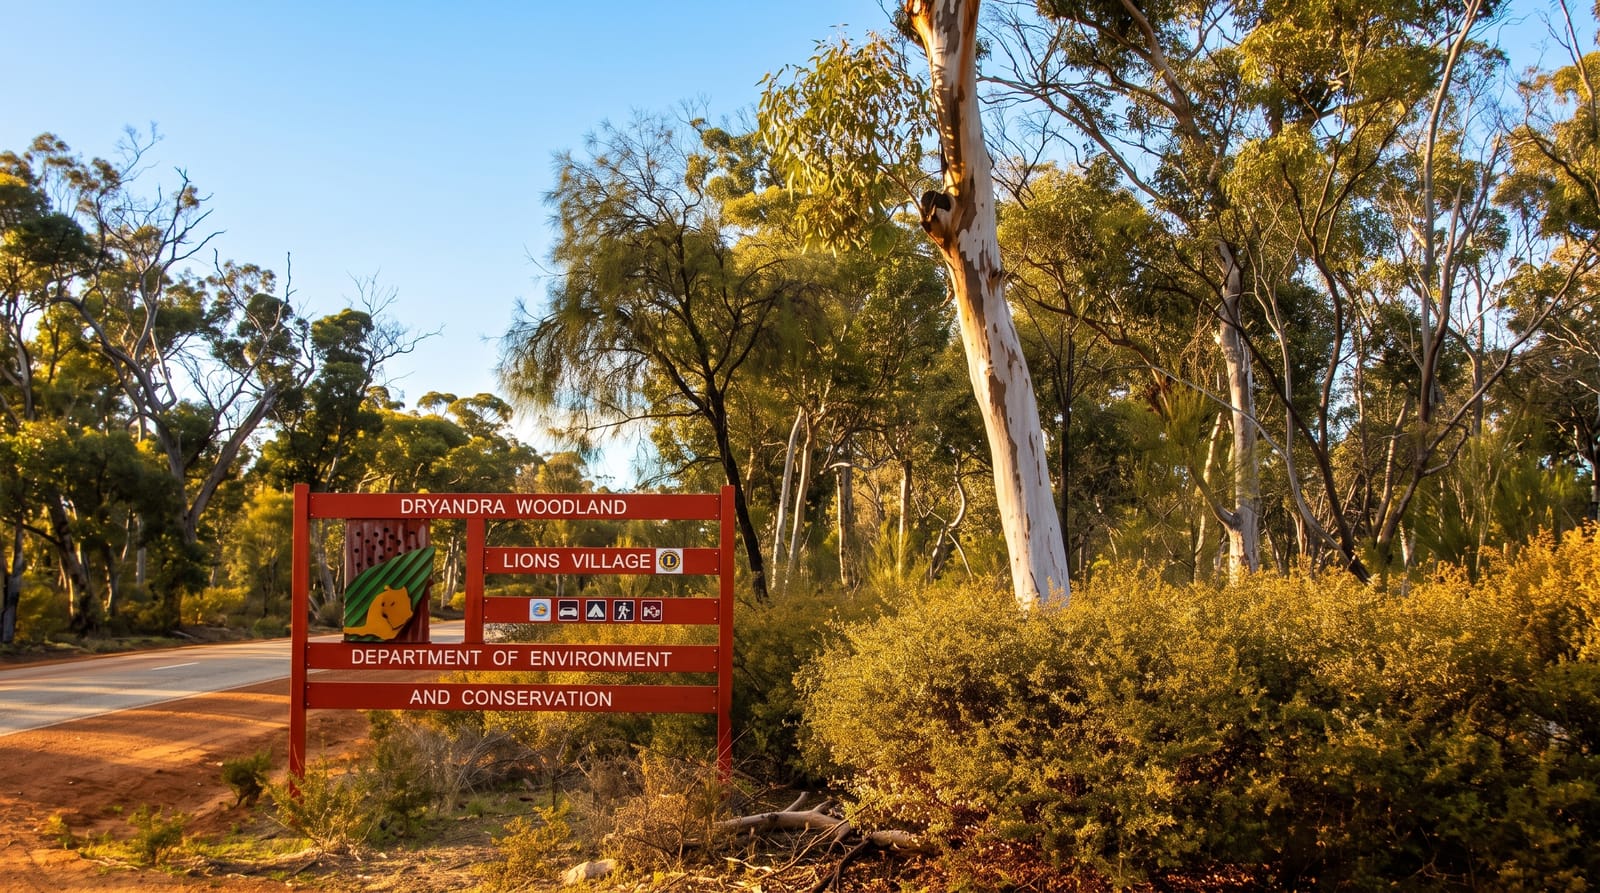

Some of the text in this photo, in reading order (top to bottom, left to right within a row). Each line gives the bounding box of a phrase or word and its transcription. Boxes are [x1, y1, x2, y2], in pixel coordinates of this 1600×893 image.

[400, 498, 627, 515] DRYANDRA WOODLAND
[503, 553, 651, 569] LIONS VILLAGE
[666, 555, 674, 566] L
[351, 649, 673, 667] DEPARTMENT OF ENVIRONMENT
[409, 689, 612, 707] AND CONSERVATION
